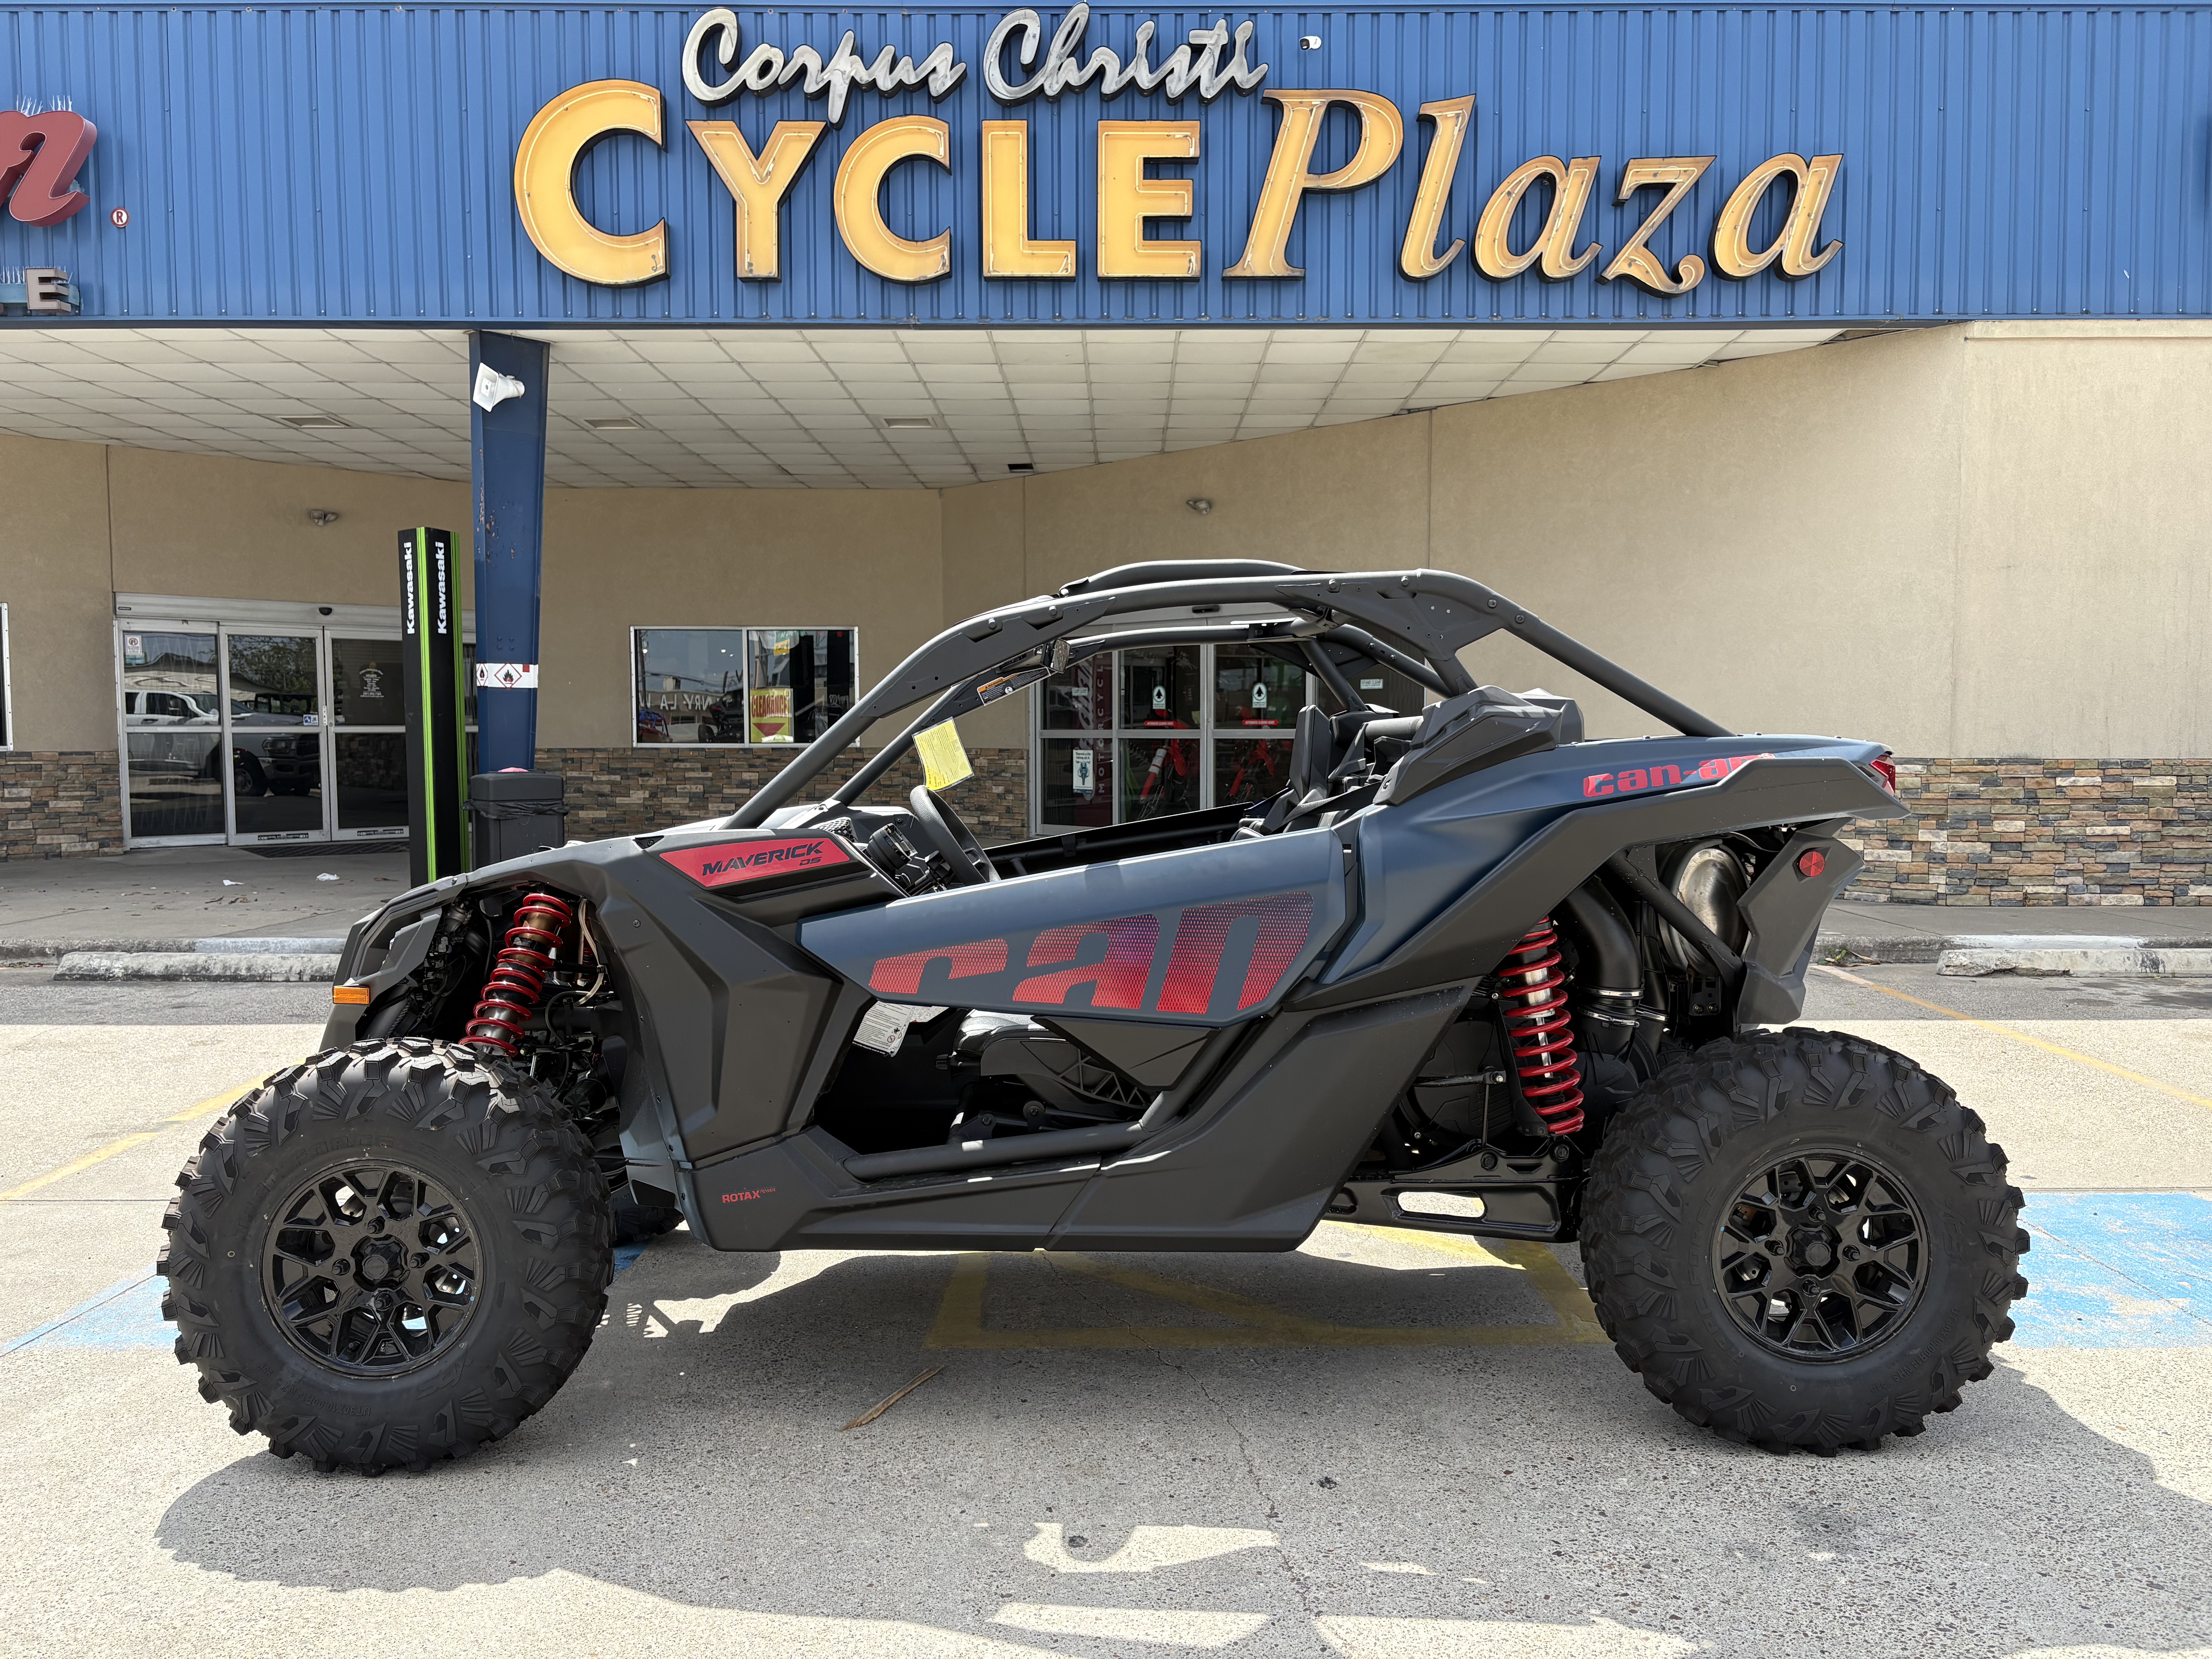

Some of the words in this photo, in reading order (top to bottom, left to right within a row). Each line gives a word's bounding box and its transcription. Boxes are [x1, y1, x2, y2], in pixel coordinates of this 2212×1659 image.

[682, 7, 967, 130] Corpus
[984, 1, 1269, 106] Christi
[513, 78, 1202, 287] CYCLE
[1222, 89, 1844, 298] Plaza
[404, 542, 415, 634] Kawasaki
[435, 542, 447, 634] Kawasaki
[751, 695, 788, 718] CLEARANCE
[702, 841, 824, 876] MAVERICK
[799, 857, 822, 866] DS
[722, 1190, 760, 1203] ROTAX
